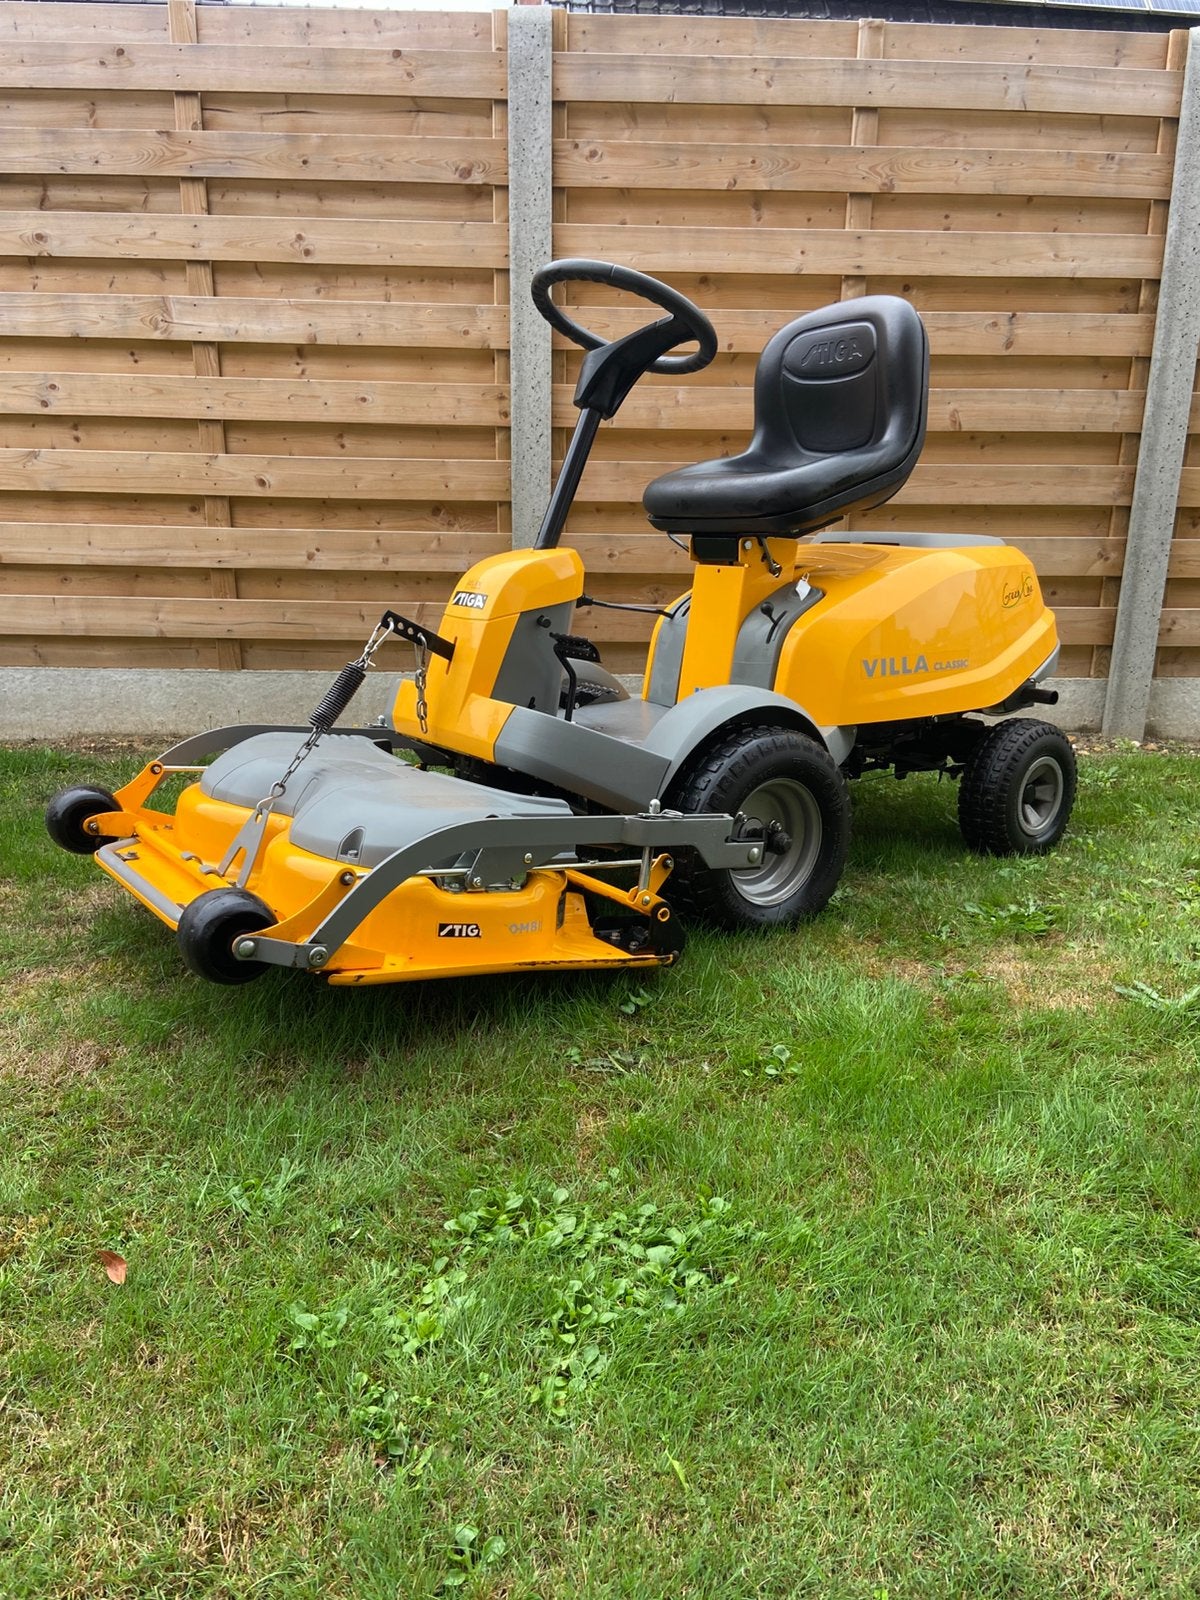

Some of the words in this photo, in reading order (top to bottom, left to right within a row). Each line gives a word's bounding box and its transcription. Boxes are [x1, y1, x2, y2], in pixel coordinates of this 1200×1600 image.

[801, 337, 863, 367] STIGA
[453, 591, 485, 609] STIGA
[862, 654, 929, 678] VILLA
[933, 658, 969, 671] CLASSIC
[439, 924, 482, 937] STIG
